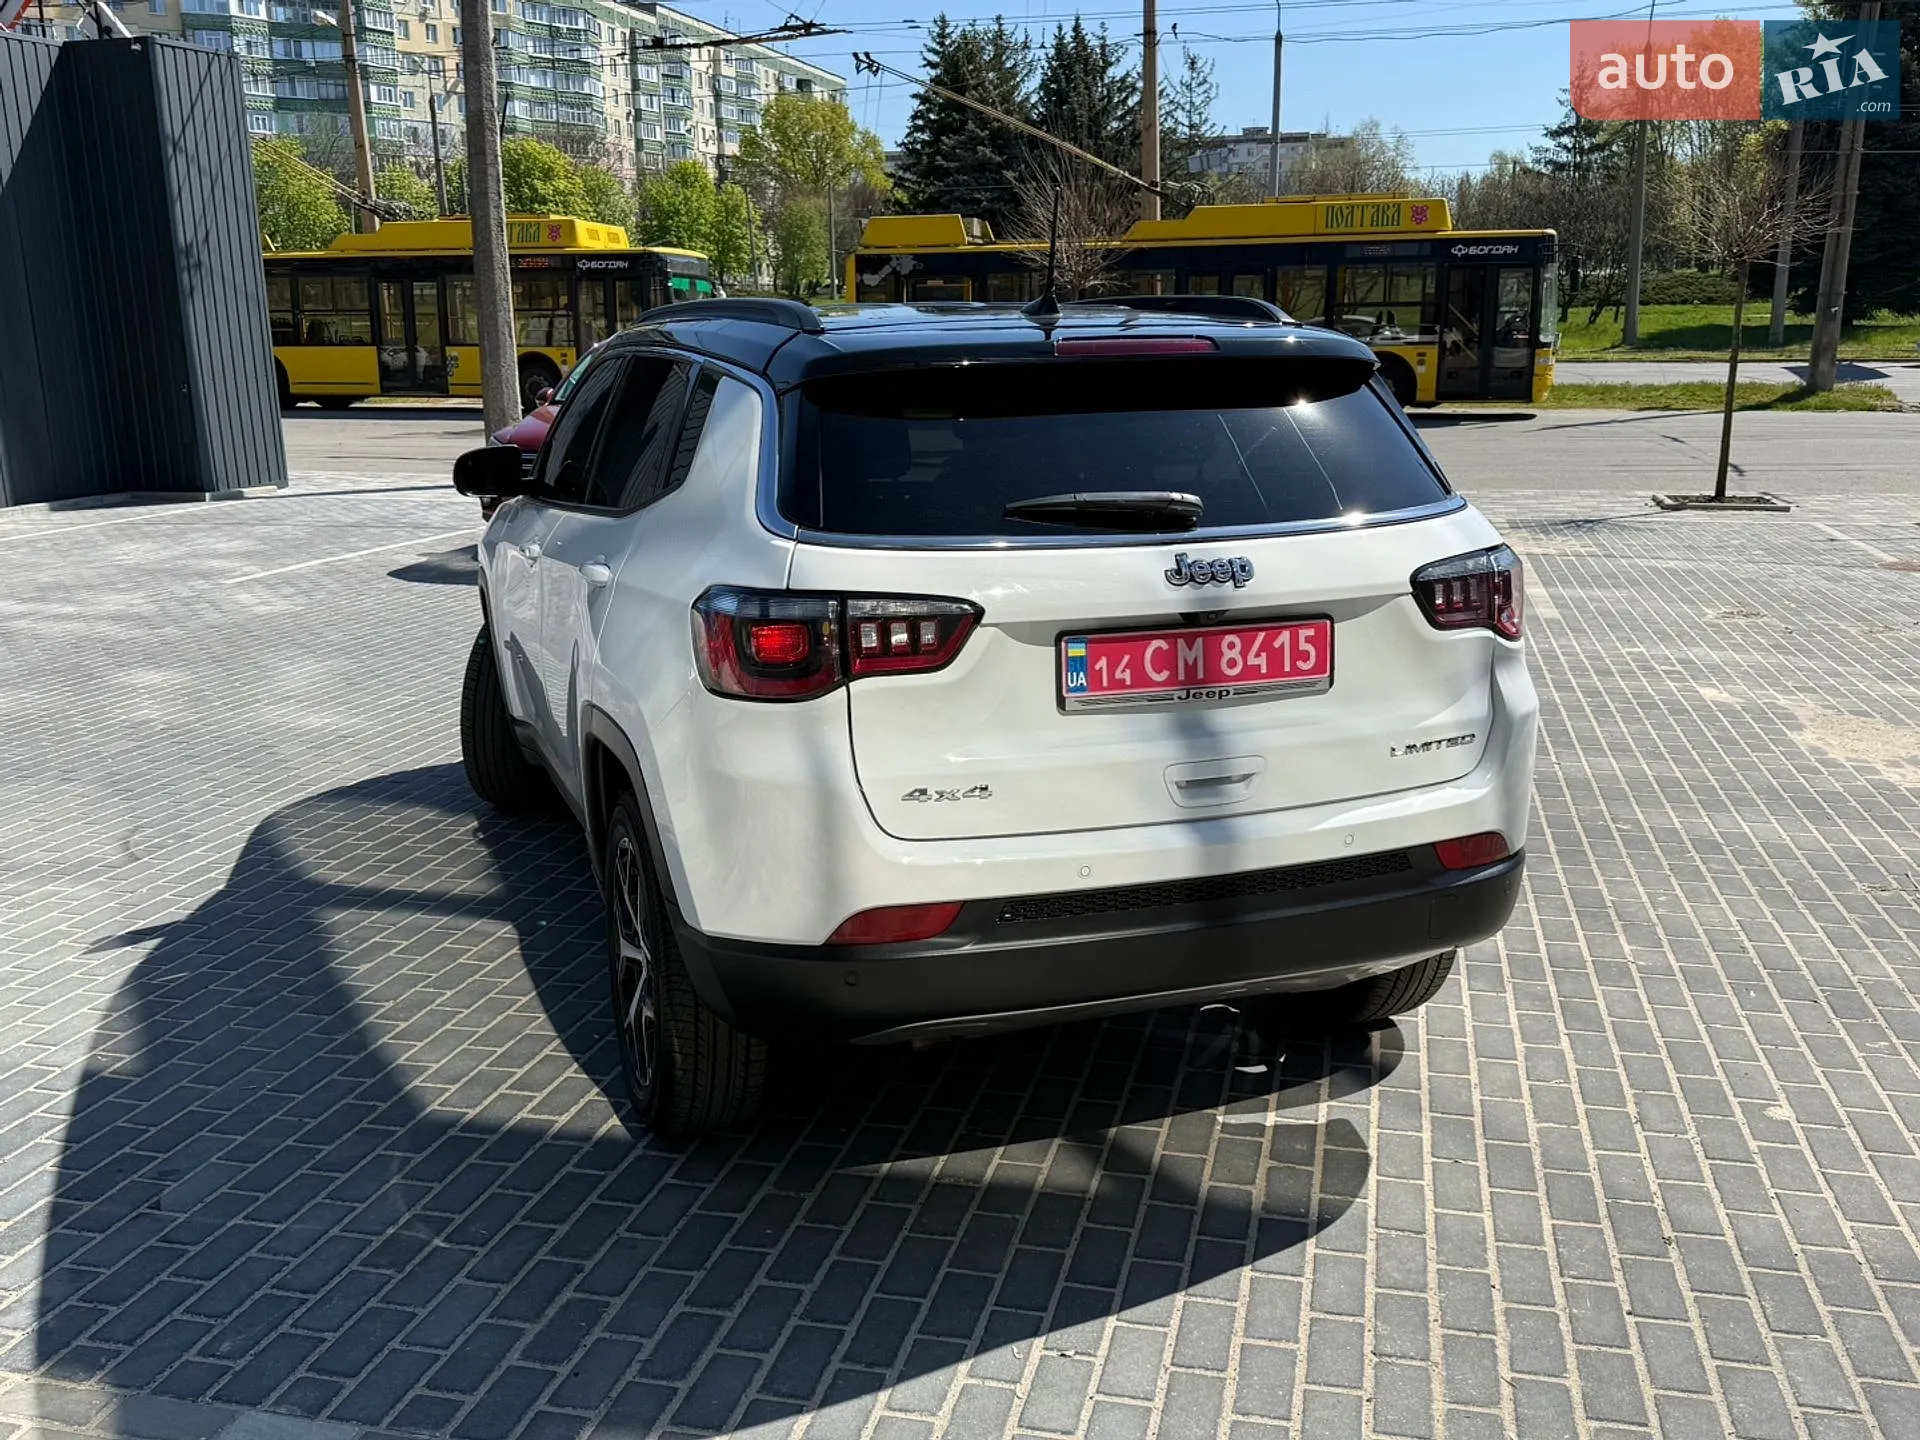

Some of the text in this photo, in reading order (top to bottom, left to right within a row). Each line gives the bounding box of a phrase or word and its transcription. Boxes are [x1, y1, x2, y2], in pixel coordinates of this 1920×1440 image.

[1325, 202, 1401, 228] ПОЛТАВА
[507, 222, 540, 243] ТАВА
[1468, 244, 1519, 255] БОГДАН
[590, 260, 629, 269] БОГДАН
[1164, 552, 1256, 589] Jeep
[1094, 628, 1317, 688] 14 CM 8415
[1067, 672, 1087, 688] UA
[1177, 687, 1231, 702] Jeep
[1389, 732, 1476, 758] LIMITED
[900, 783, 993, 803] 4x4
